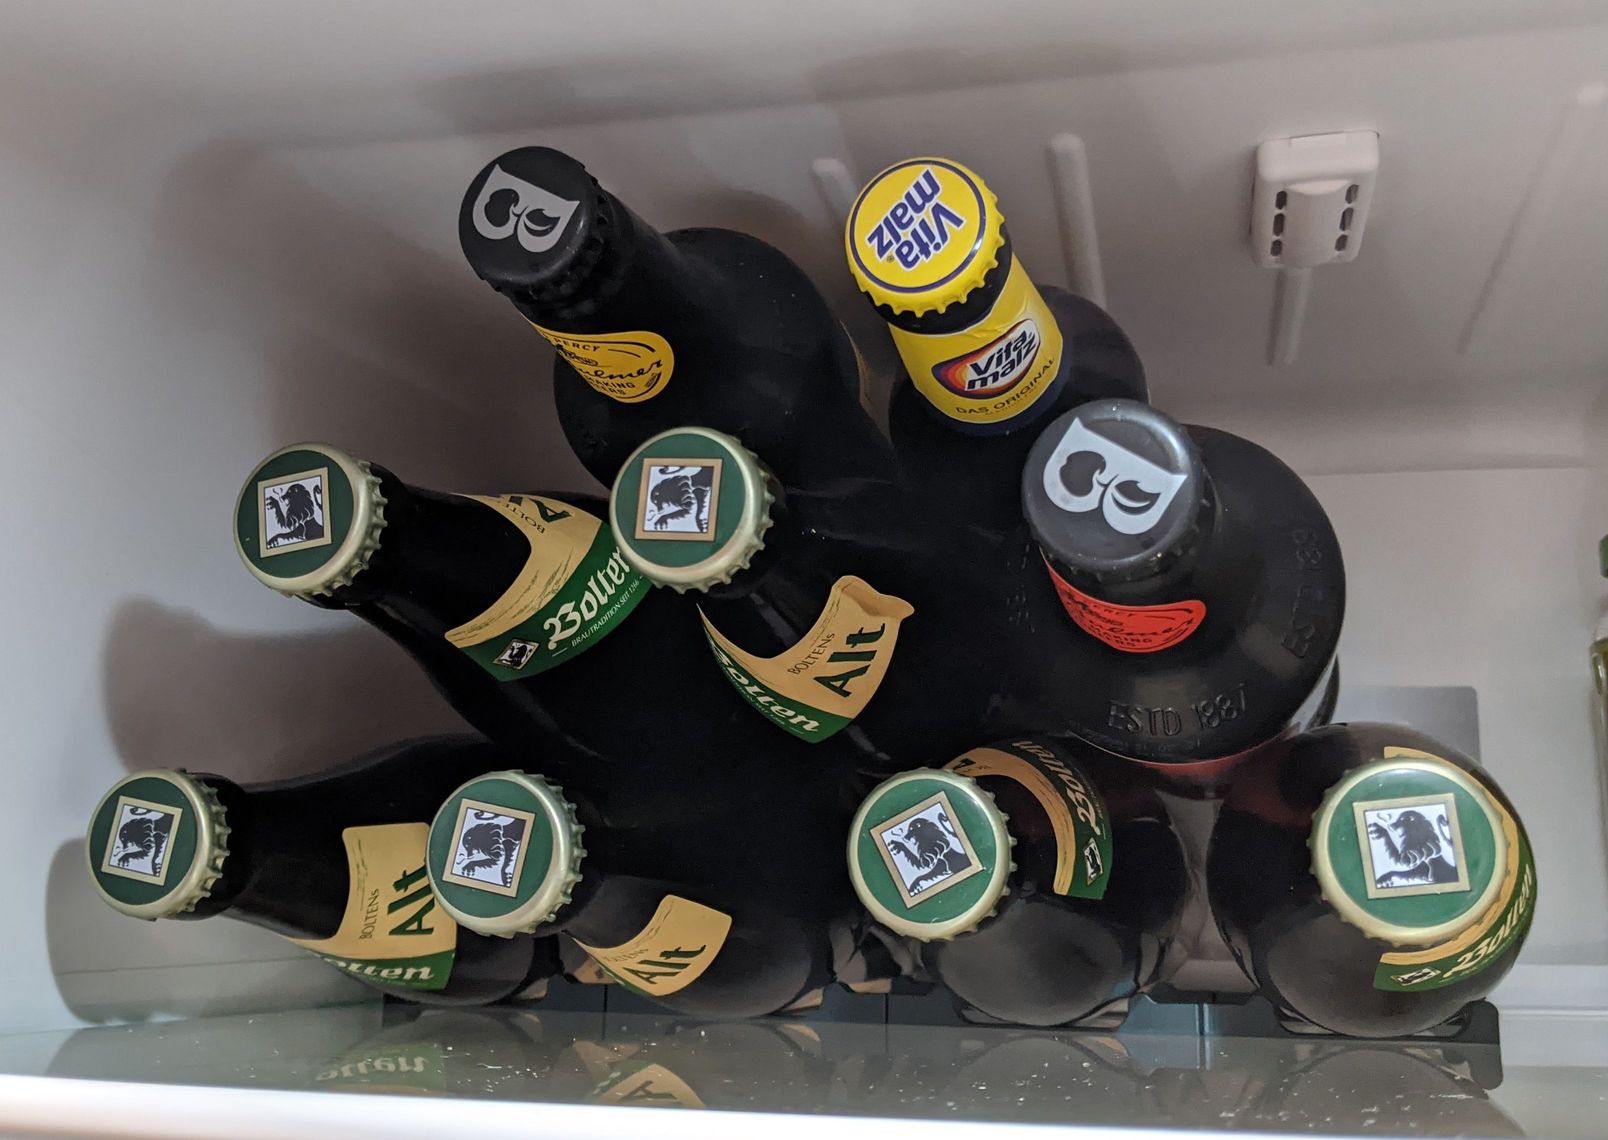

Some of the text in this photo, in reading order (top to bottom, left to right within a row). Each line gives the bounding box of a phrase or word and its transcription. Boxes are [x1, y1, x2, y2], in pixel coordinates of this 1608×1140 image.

[868, 168, 941, 259] malz
[896, 202, 965, 269] Vita
[966, 333, 1037, 390] malz
[968, 329, 1029, 376] Vita
[955, 405, 989, 415] DAS
[994, 358, 1055, 410] ORIGINAL
[570, 602, 622, 648] BRAUTRADITION
[619, 591, 632, 608] SEIT
[787, 632, 836, 675] BOLTENS
[813, 622, 886, 698] Alt
[1107, 699, 1183, 737] ESTD
[359, 888, 380, 941] BOLTENS
[387, 858, 436, 936] Alt
[622, 944, 707, 985] Alt
